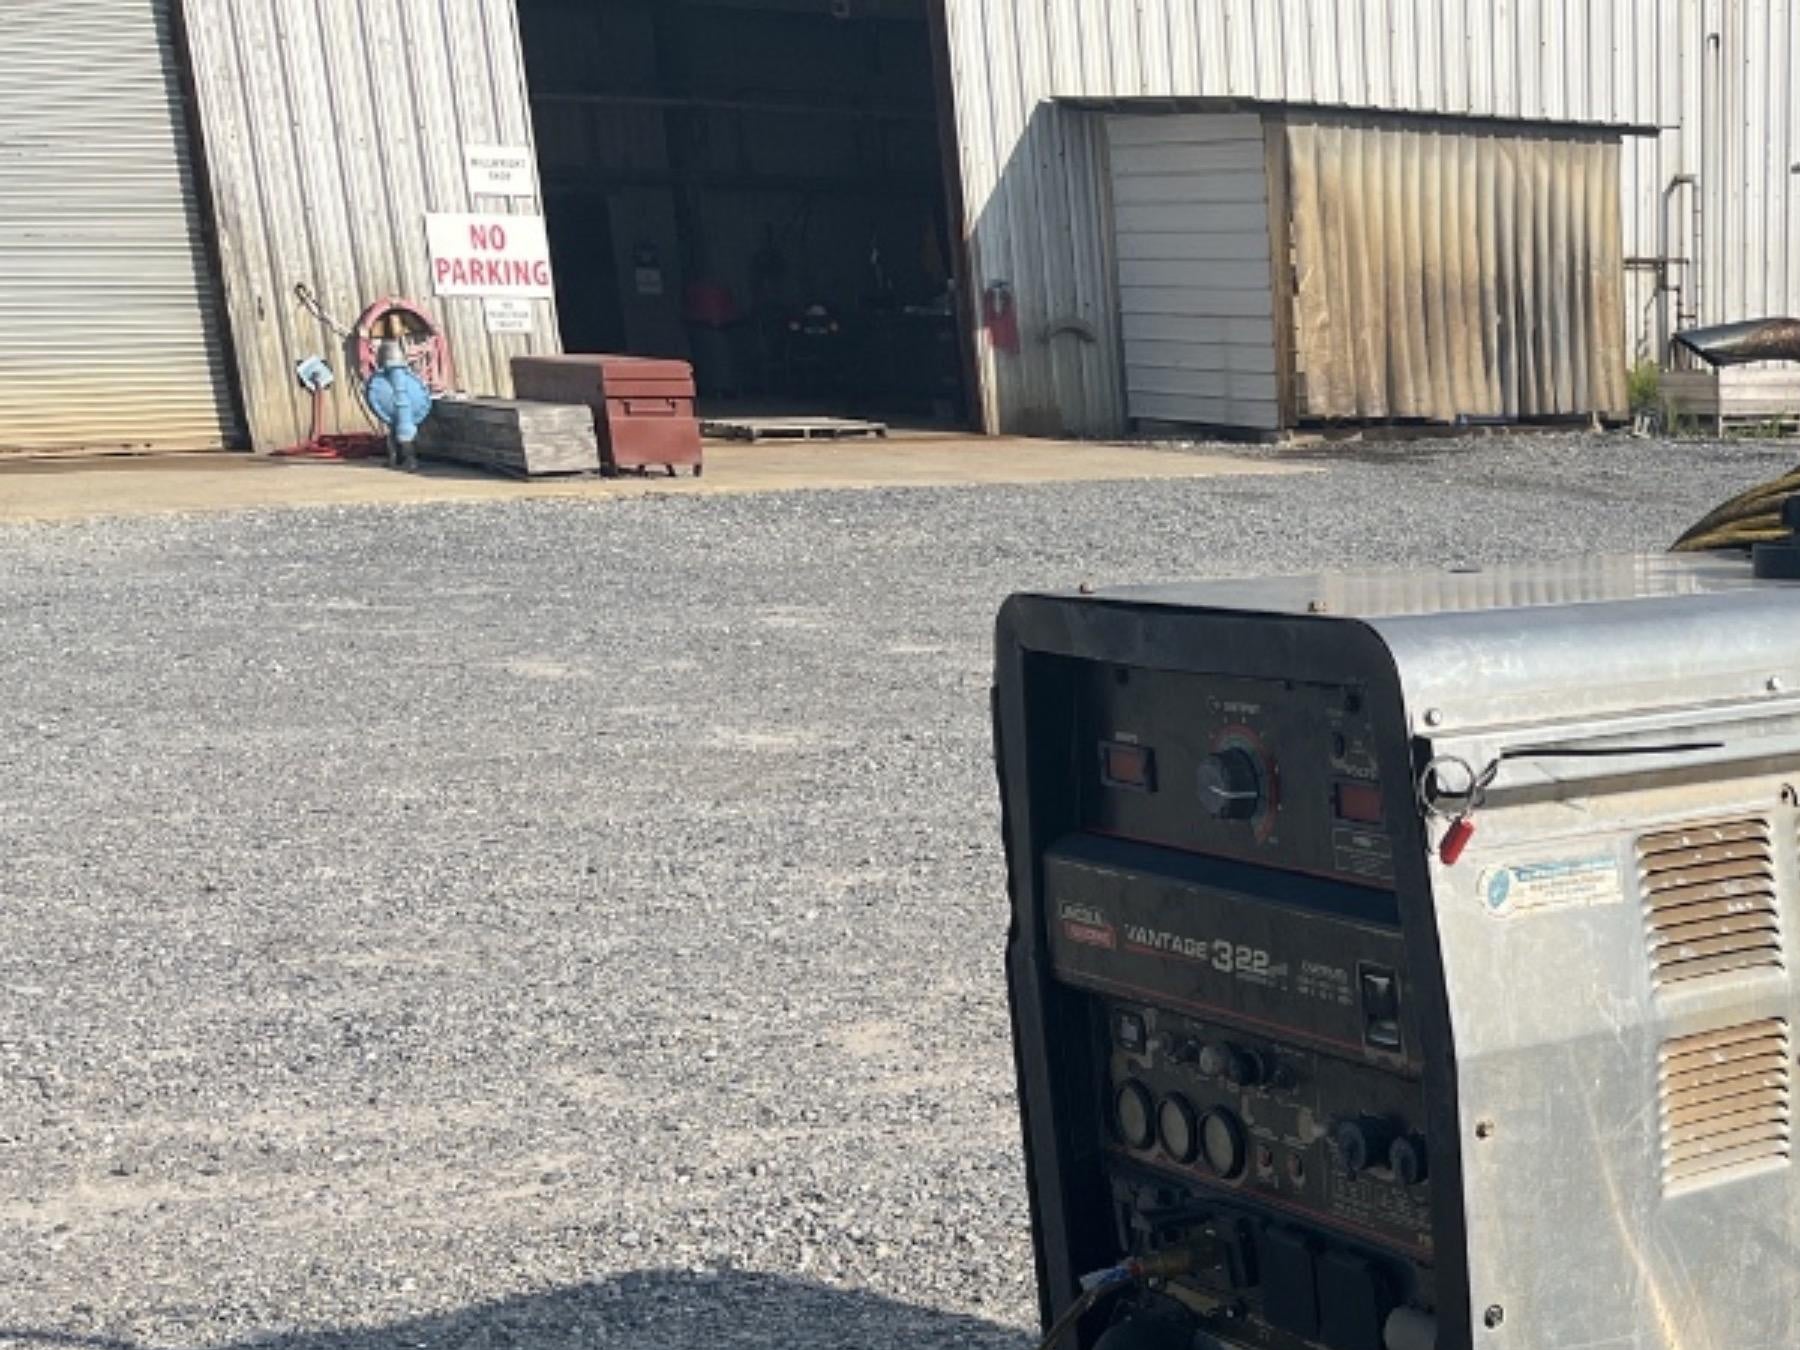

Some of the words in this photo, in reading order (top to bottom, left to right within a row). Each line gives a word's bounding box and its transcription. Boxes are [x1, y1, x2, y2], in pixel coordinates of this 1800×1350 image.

[469, 223, 506, 251] NO
[434, 257, 549, 286] PARKING
[1124, 923, 1208, 961] VANTAGE
[1210, 938, 1270, 974] 322
